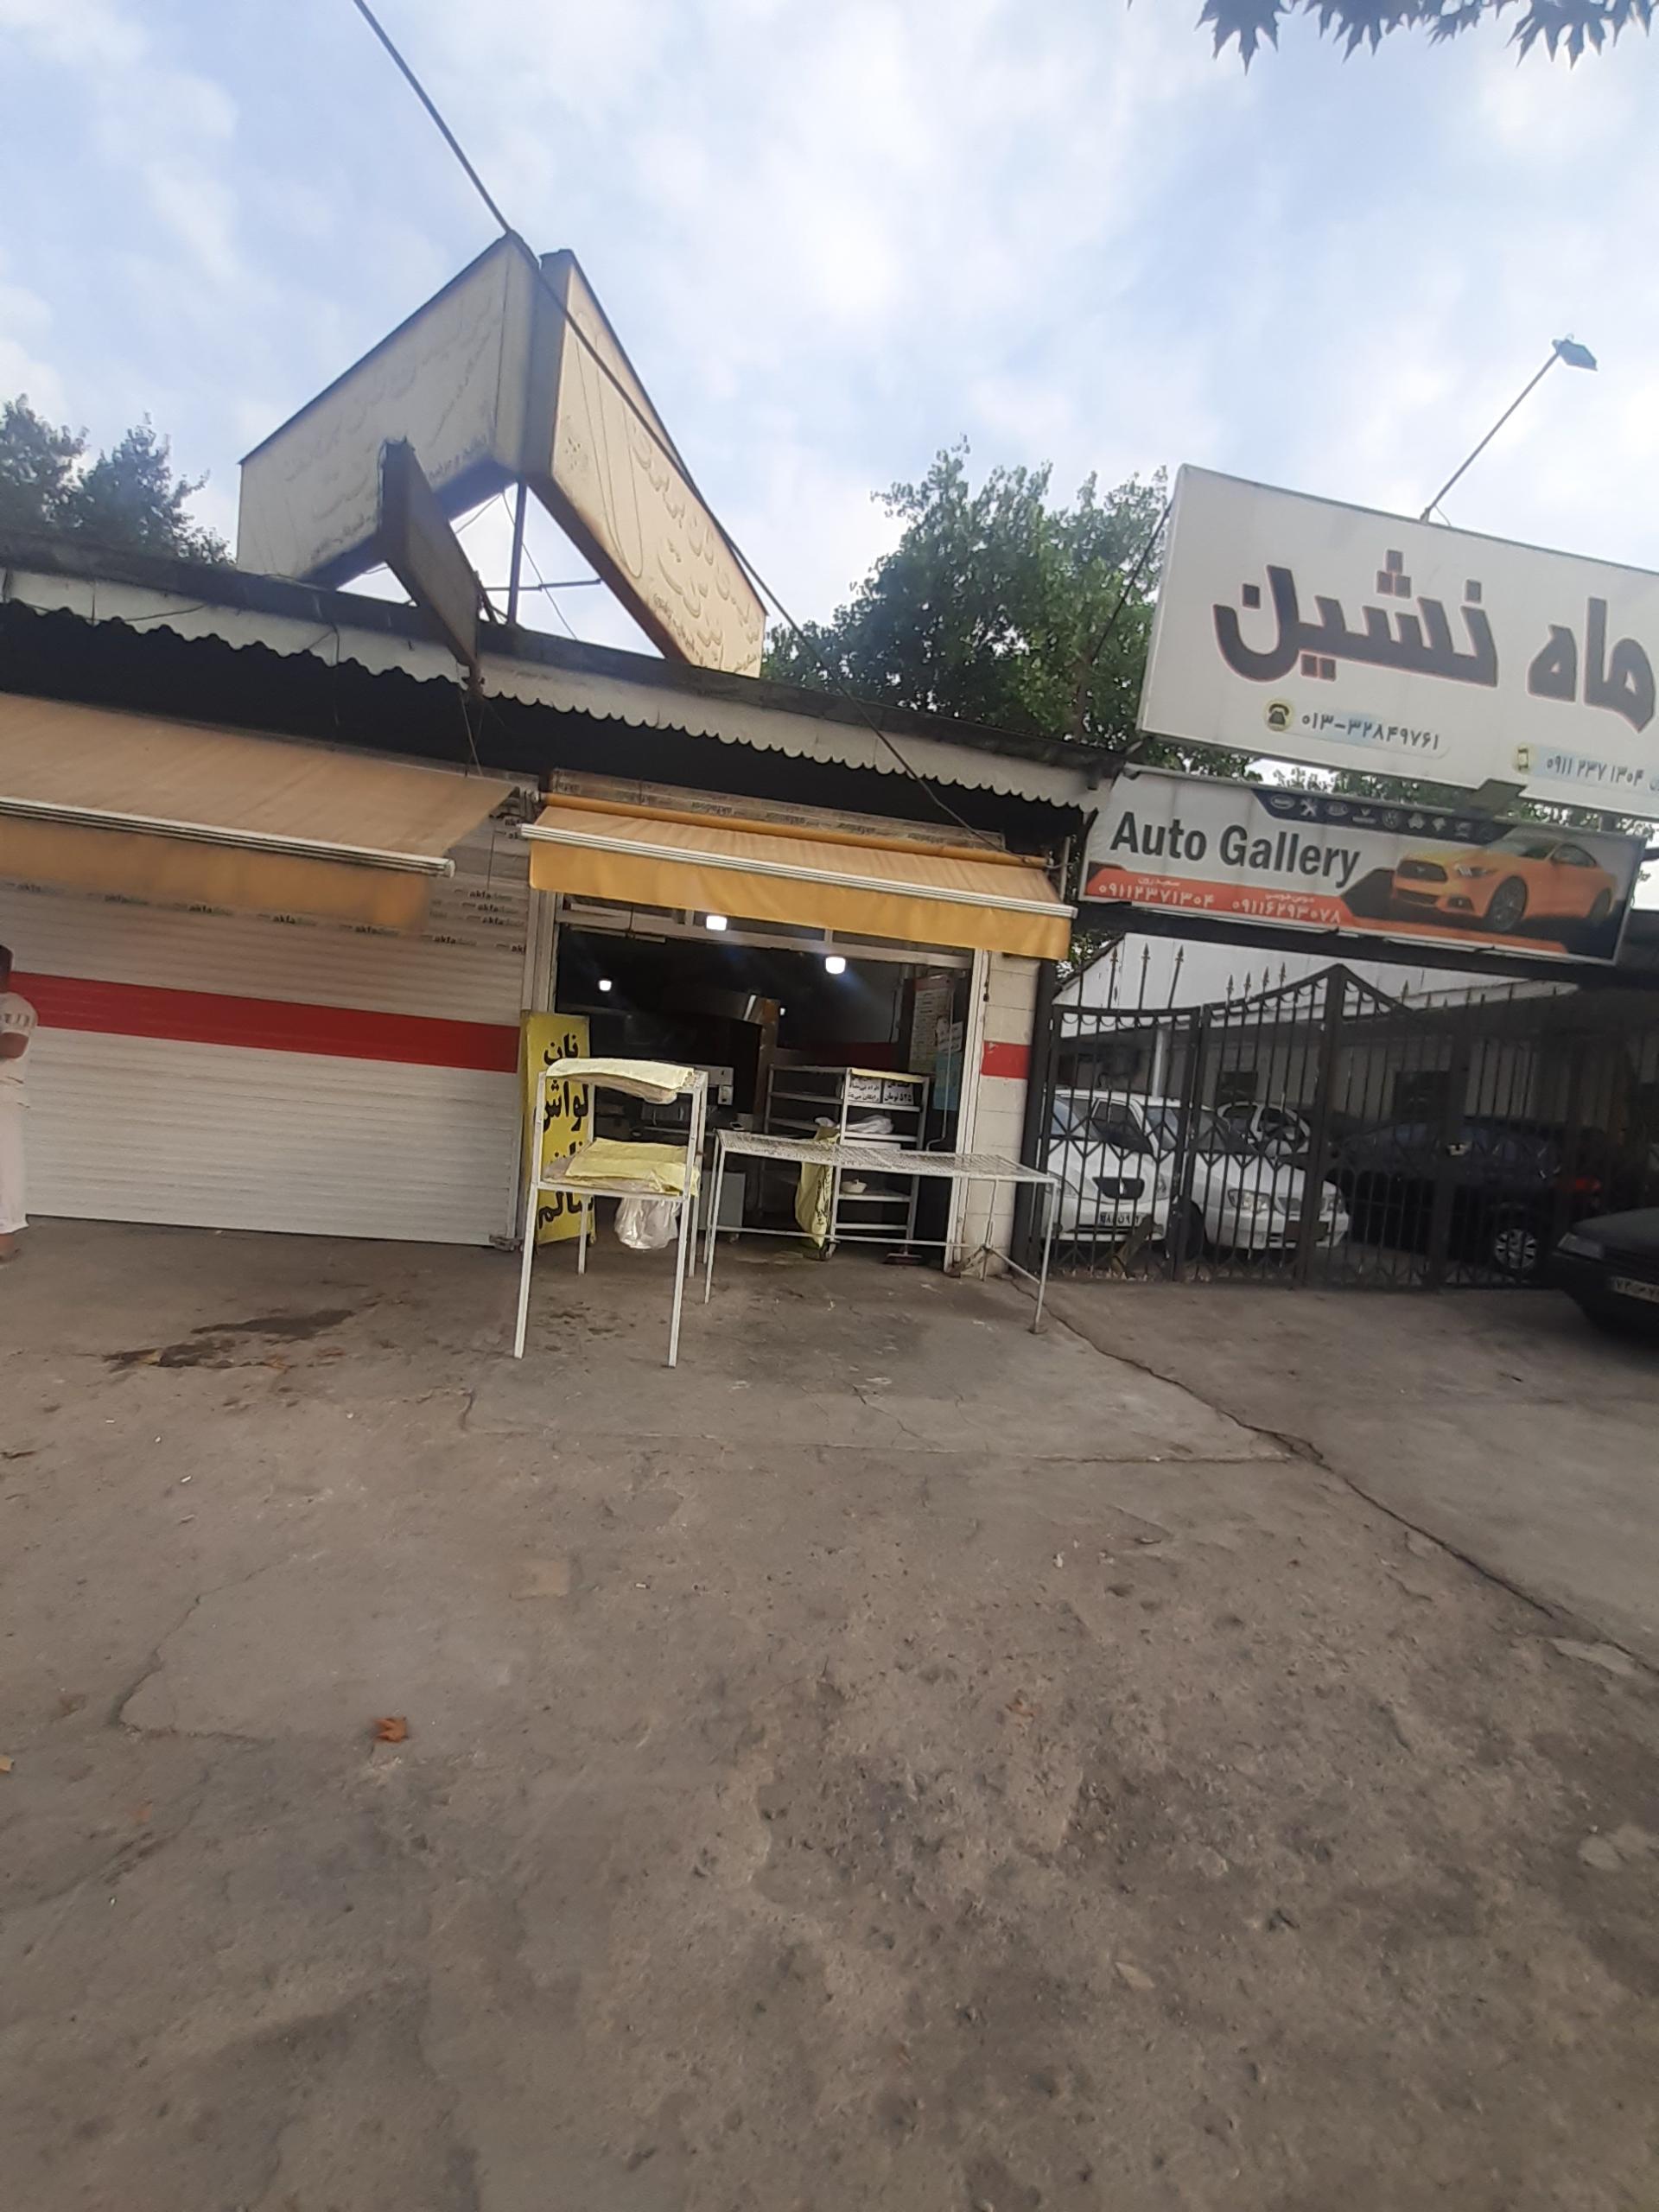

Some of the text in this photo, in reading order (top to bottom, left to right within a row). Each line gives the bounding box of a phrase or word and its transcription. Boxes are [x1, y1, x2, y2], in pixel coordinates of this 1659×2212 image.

[1212, 550, 1656, 734] ماه نشین
[1301, 712, 1440, 750] ۰۱۳-۳۲۸۴۹۷۶۱
[1109, 810, 1361, 889] Auto Gallery
[543, 1033, 579, 1066] نان
[543, 1079, 589, 1133] لواش
